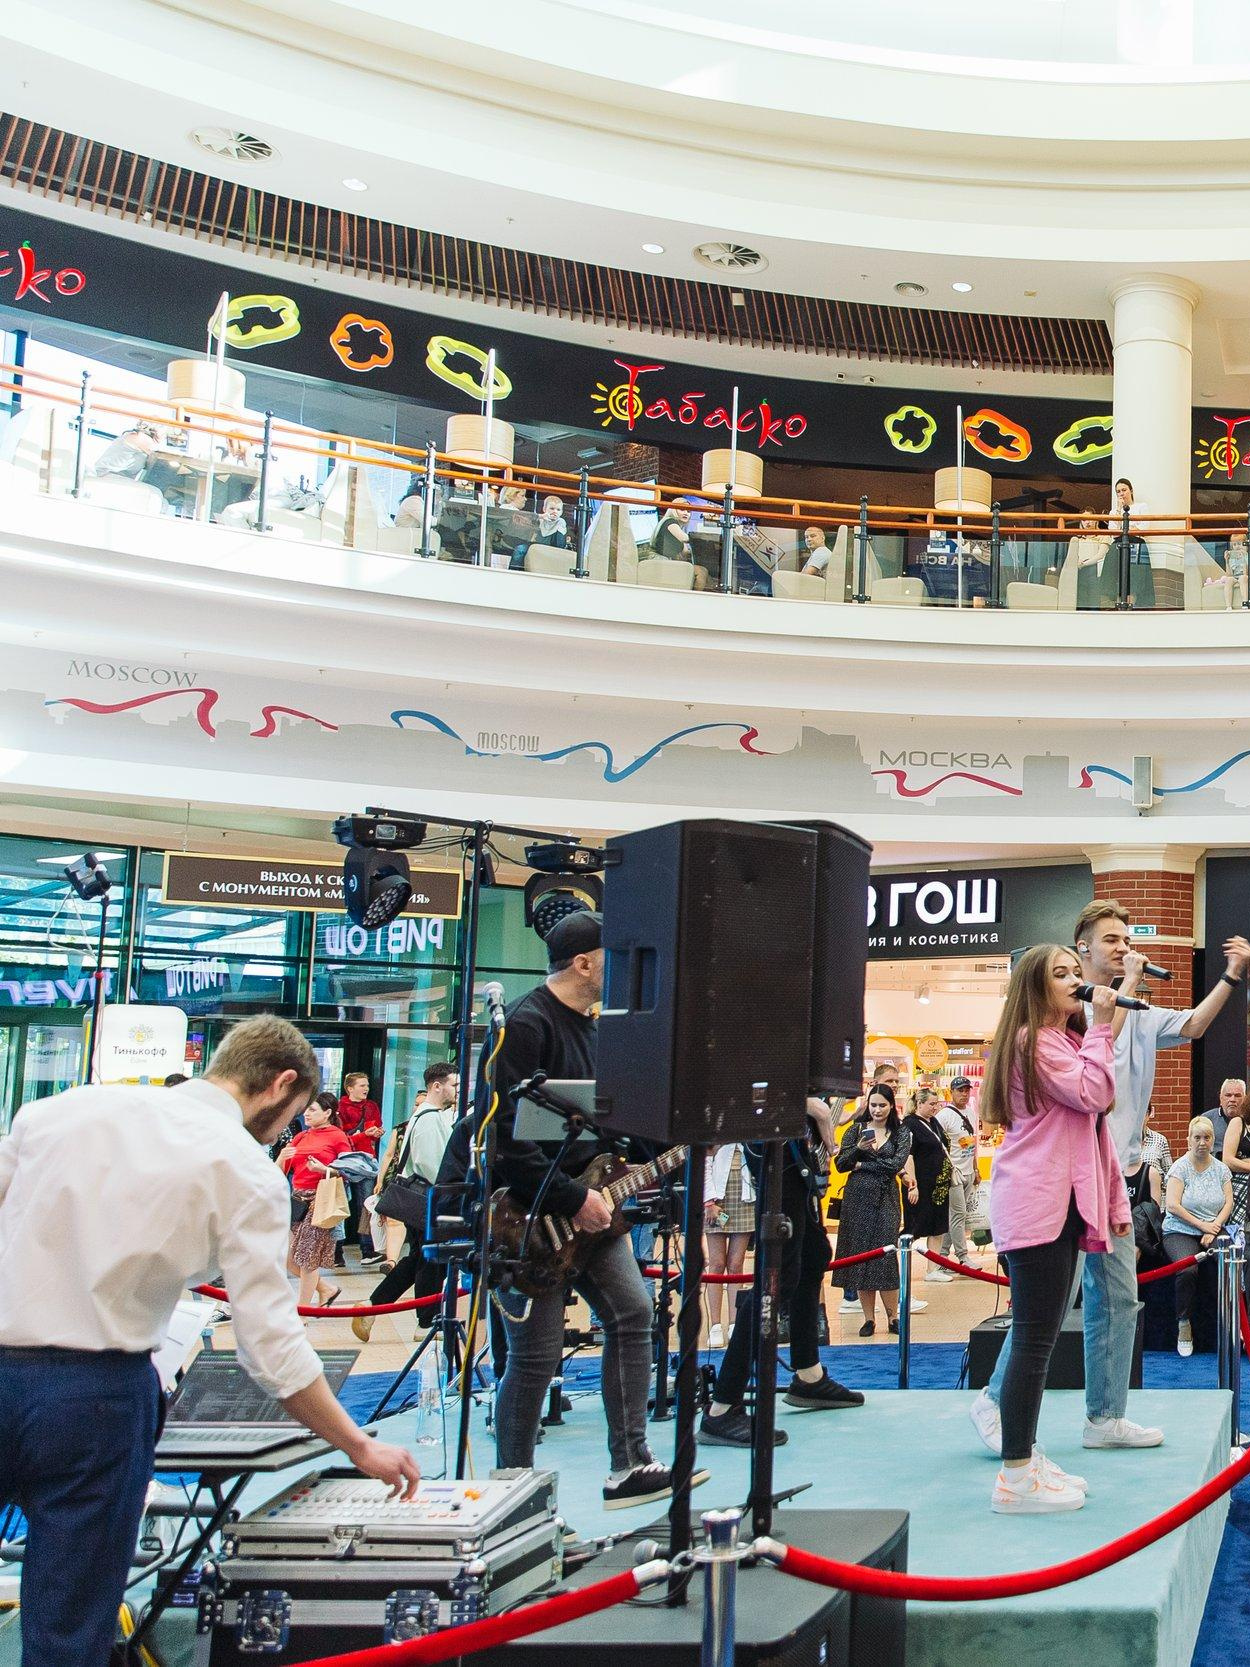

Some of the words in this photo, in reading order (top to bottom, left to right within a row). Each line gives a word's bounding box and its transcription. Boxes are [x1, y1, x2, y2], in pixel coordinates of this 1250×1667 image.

[614, 359, 807, 448] Табаско
[67, 659, 198, 687] MOSCOW
[477, 731, 540, 752] MOSCOW
[880, 750, 1012, 769] МОСКВА
[260, 871, 311, 884] ВЫХОД
[315, 875, 325, 885] К
[199, 881, 209, 892] С
[212, 882, 321, 898] МОНУМЕНТОМ
[889, 878, 997, 928] ГОШ
[893, 936, 902, 946] и
[908, 931, 999, 946] косметика
[113, 1046, 167, 1057] Тинькофф
